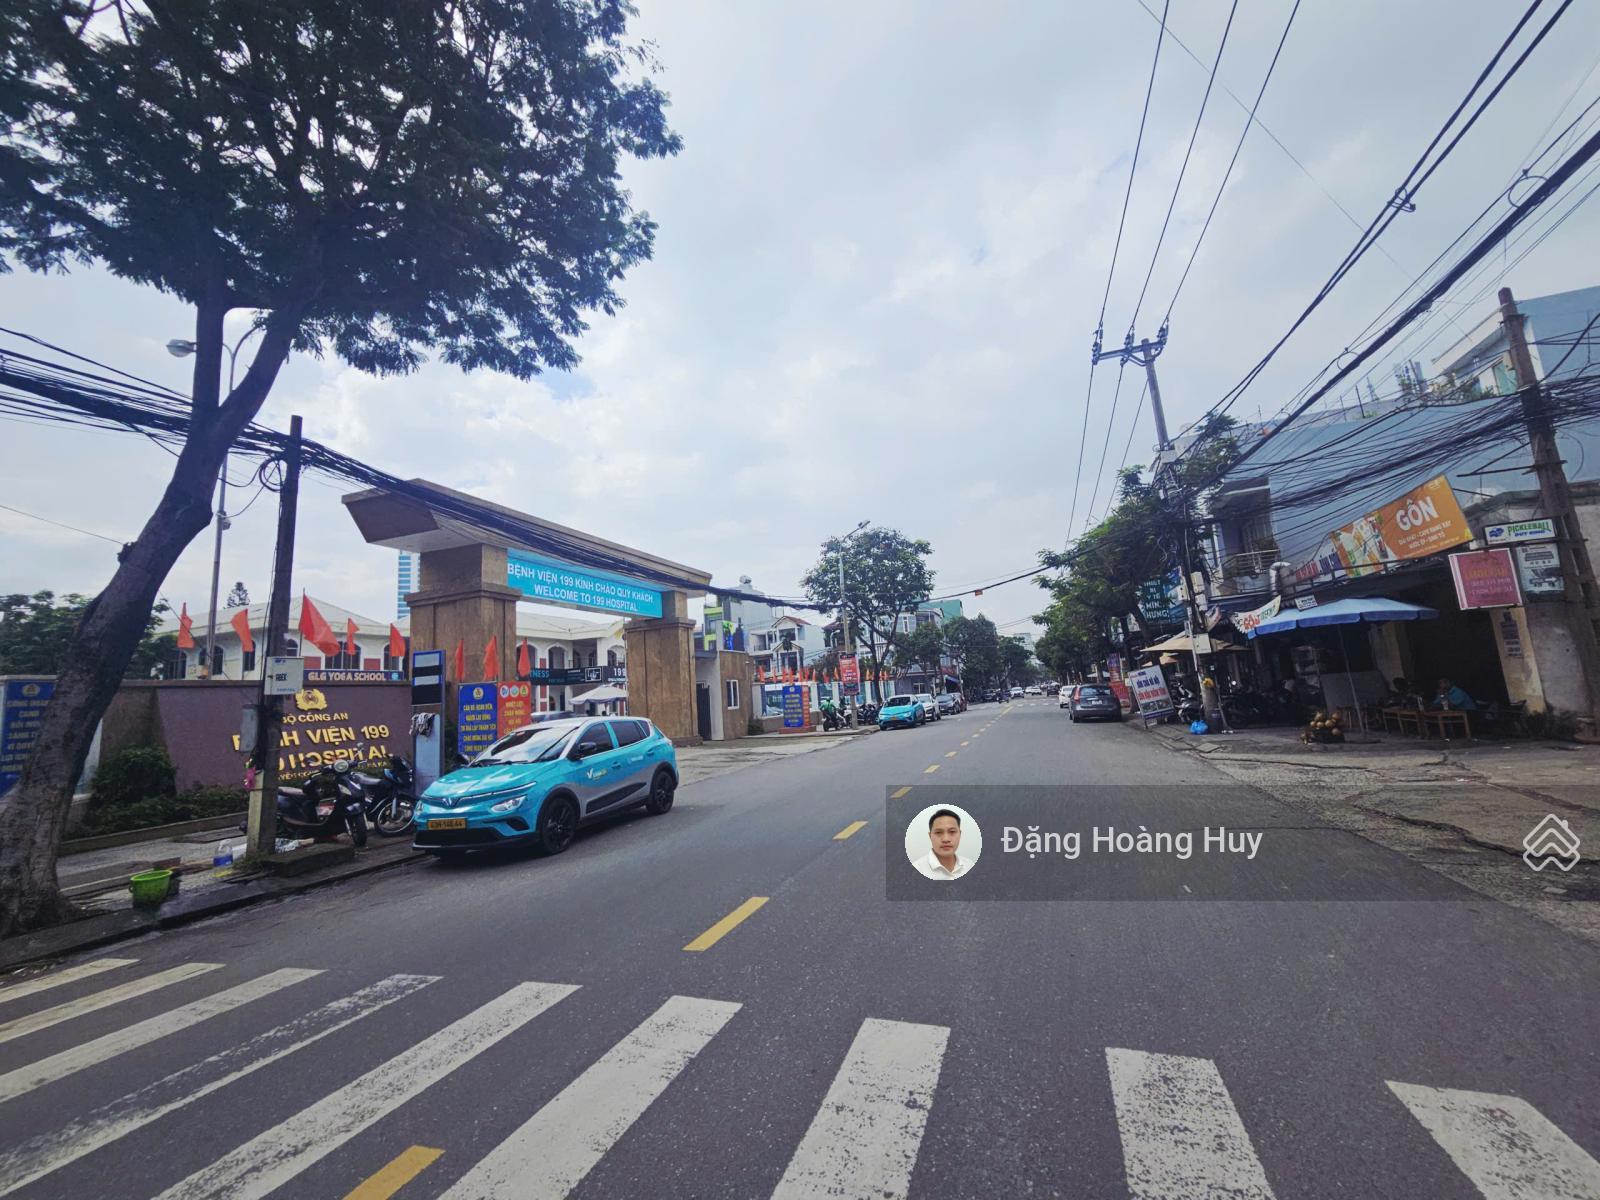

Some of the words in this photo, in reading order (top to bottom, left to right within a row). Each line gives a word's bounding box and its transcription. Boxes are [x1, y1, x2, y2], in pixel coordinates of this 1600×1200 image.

[1396, 496, 1439, 531] GÔN
[507, 562, 535, 579] BỆNH
[537, 569, 558, 585] VIỆN
[560, 576, 574, 587] 199
[534, 584, 579, 602] WELCOME
[581, 592, 591, 604] TO
[592, 595, 605, 606] 199
[606, 599, 638, 612] HOSPITAL
[308, 671, 327, 681] GLG
[329, 671, 353, 681] YOGA
[354, 672, 386, 681] SCHOOL
[298, 712, 331, 723] CÔNG
[333, 712, 349, 721] AN
[305, 725, 356, 746] VIỆN
[361, 725, 390, 740] 199
